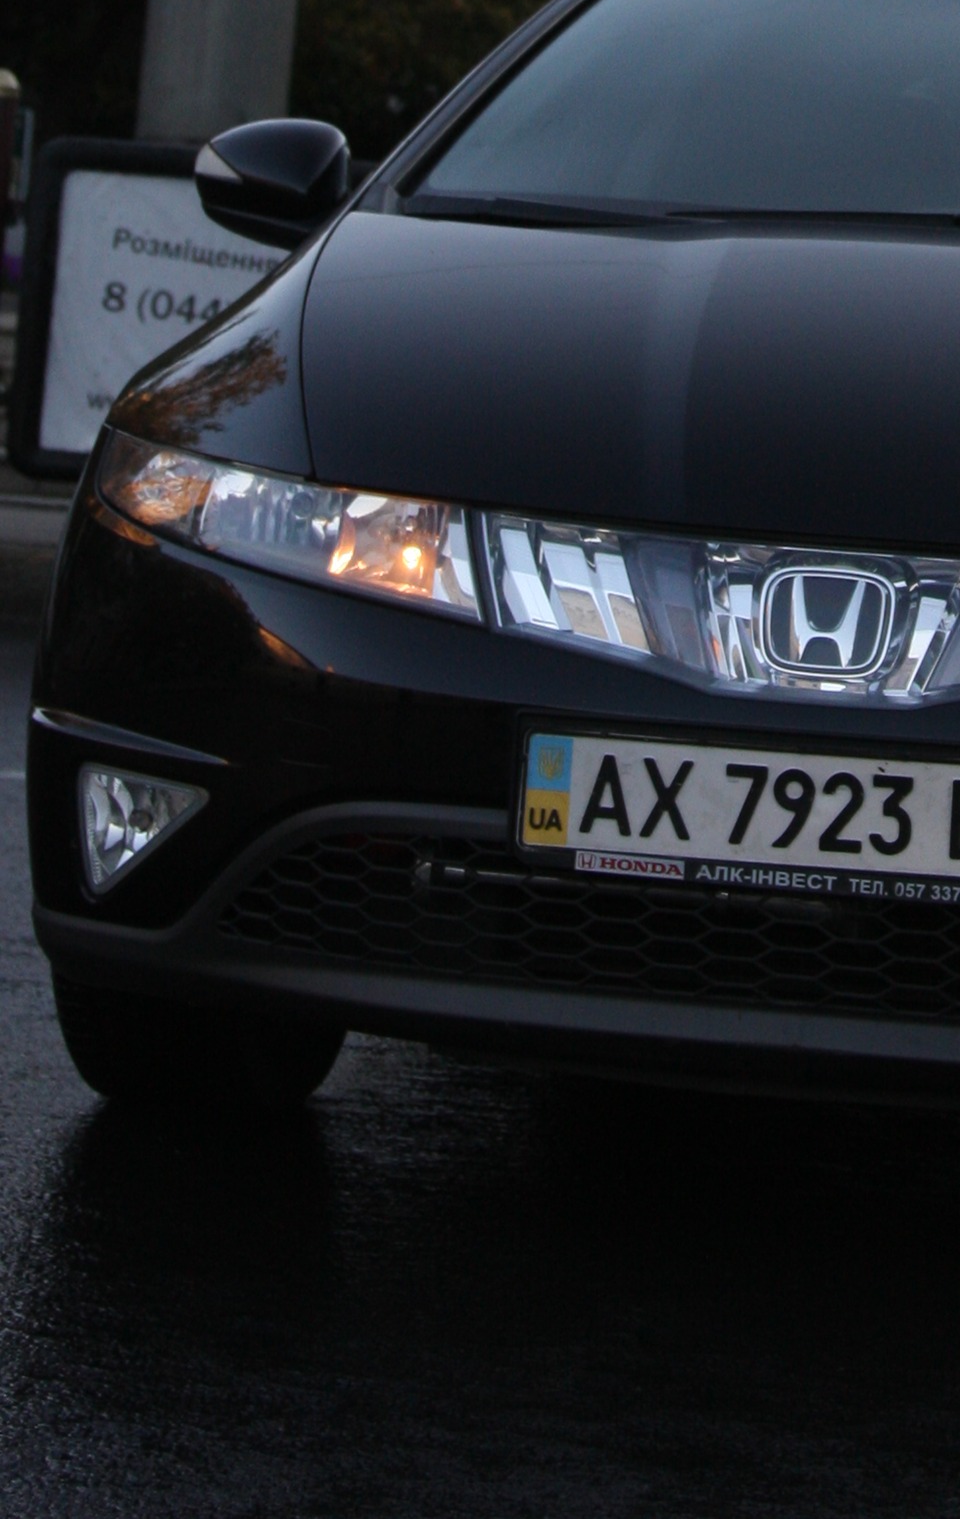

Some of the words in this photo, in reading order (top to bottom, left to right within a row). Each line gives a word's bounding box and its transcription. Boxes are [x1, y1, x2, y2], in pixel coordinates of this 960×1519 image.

[102, 281, 127, 313] 8
[137, 288, 230, 324] (044
[528, 807, 563, 831] UA
[579, 754, 695, 841] AX
[725, 762, 915, 856] 7923
[599, 855, 684, 877] HONDA
[696, 864, 838, 892] АЛК-ІНВЕСТ
[849, 877, 889, 896] ТЕЛ.
[894, 882, 926, 899] 057
